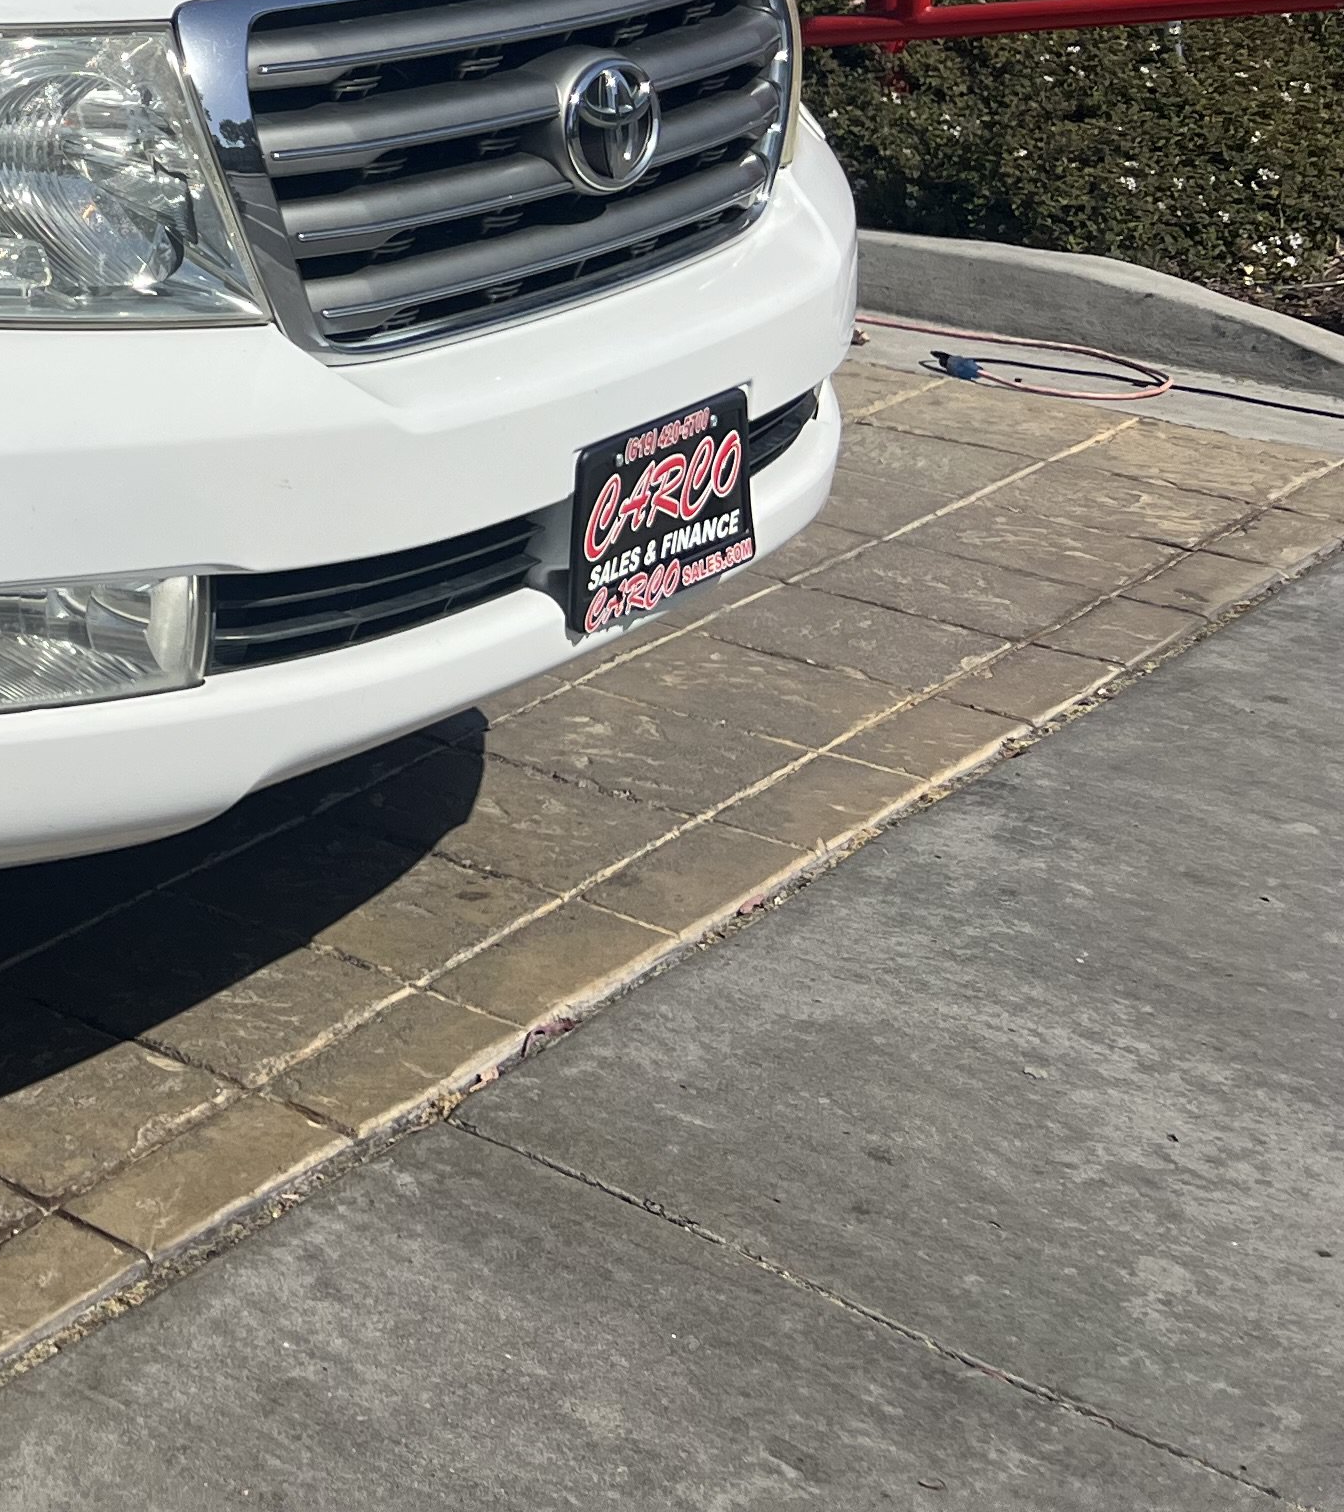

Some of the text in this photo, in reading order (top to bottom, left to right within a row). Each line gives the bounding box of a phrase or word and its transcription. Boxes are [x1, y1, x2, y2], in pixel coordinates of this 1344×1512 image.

[625, 407, 711, 465] (619) 420-5700
[584, 430, 741, 562] CARCO
[584, 538, 754, 634] CARCO SALES.COM
[587, 509, 740, 591] SALES & FINANCE
